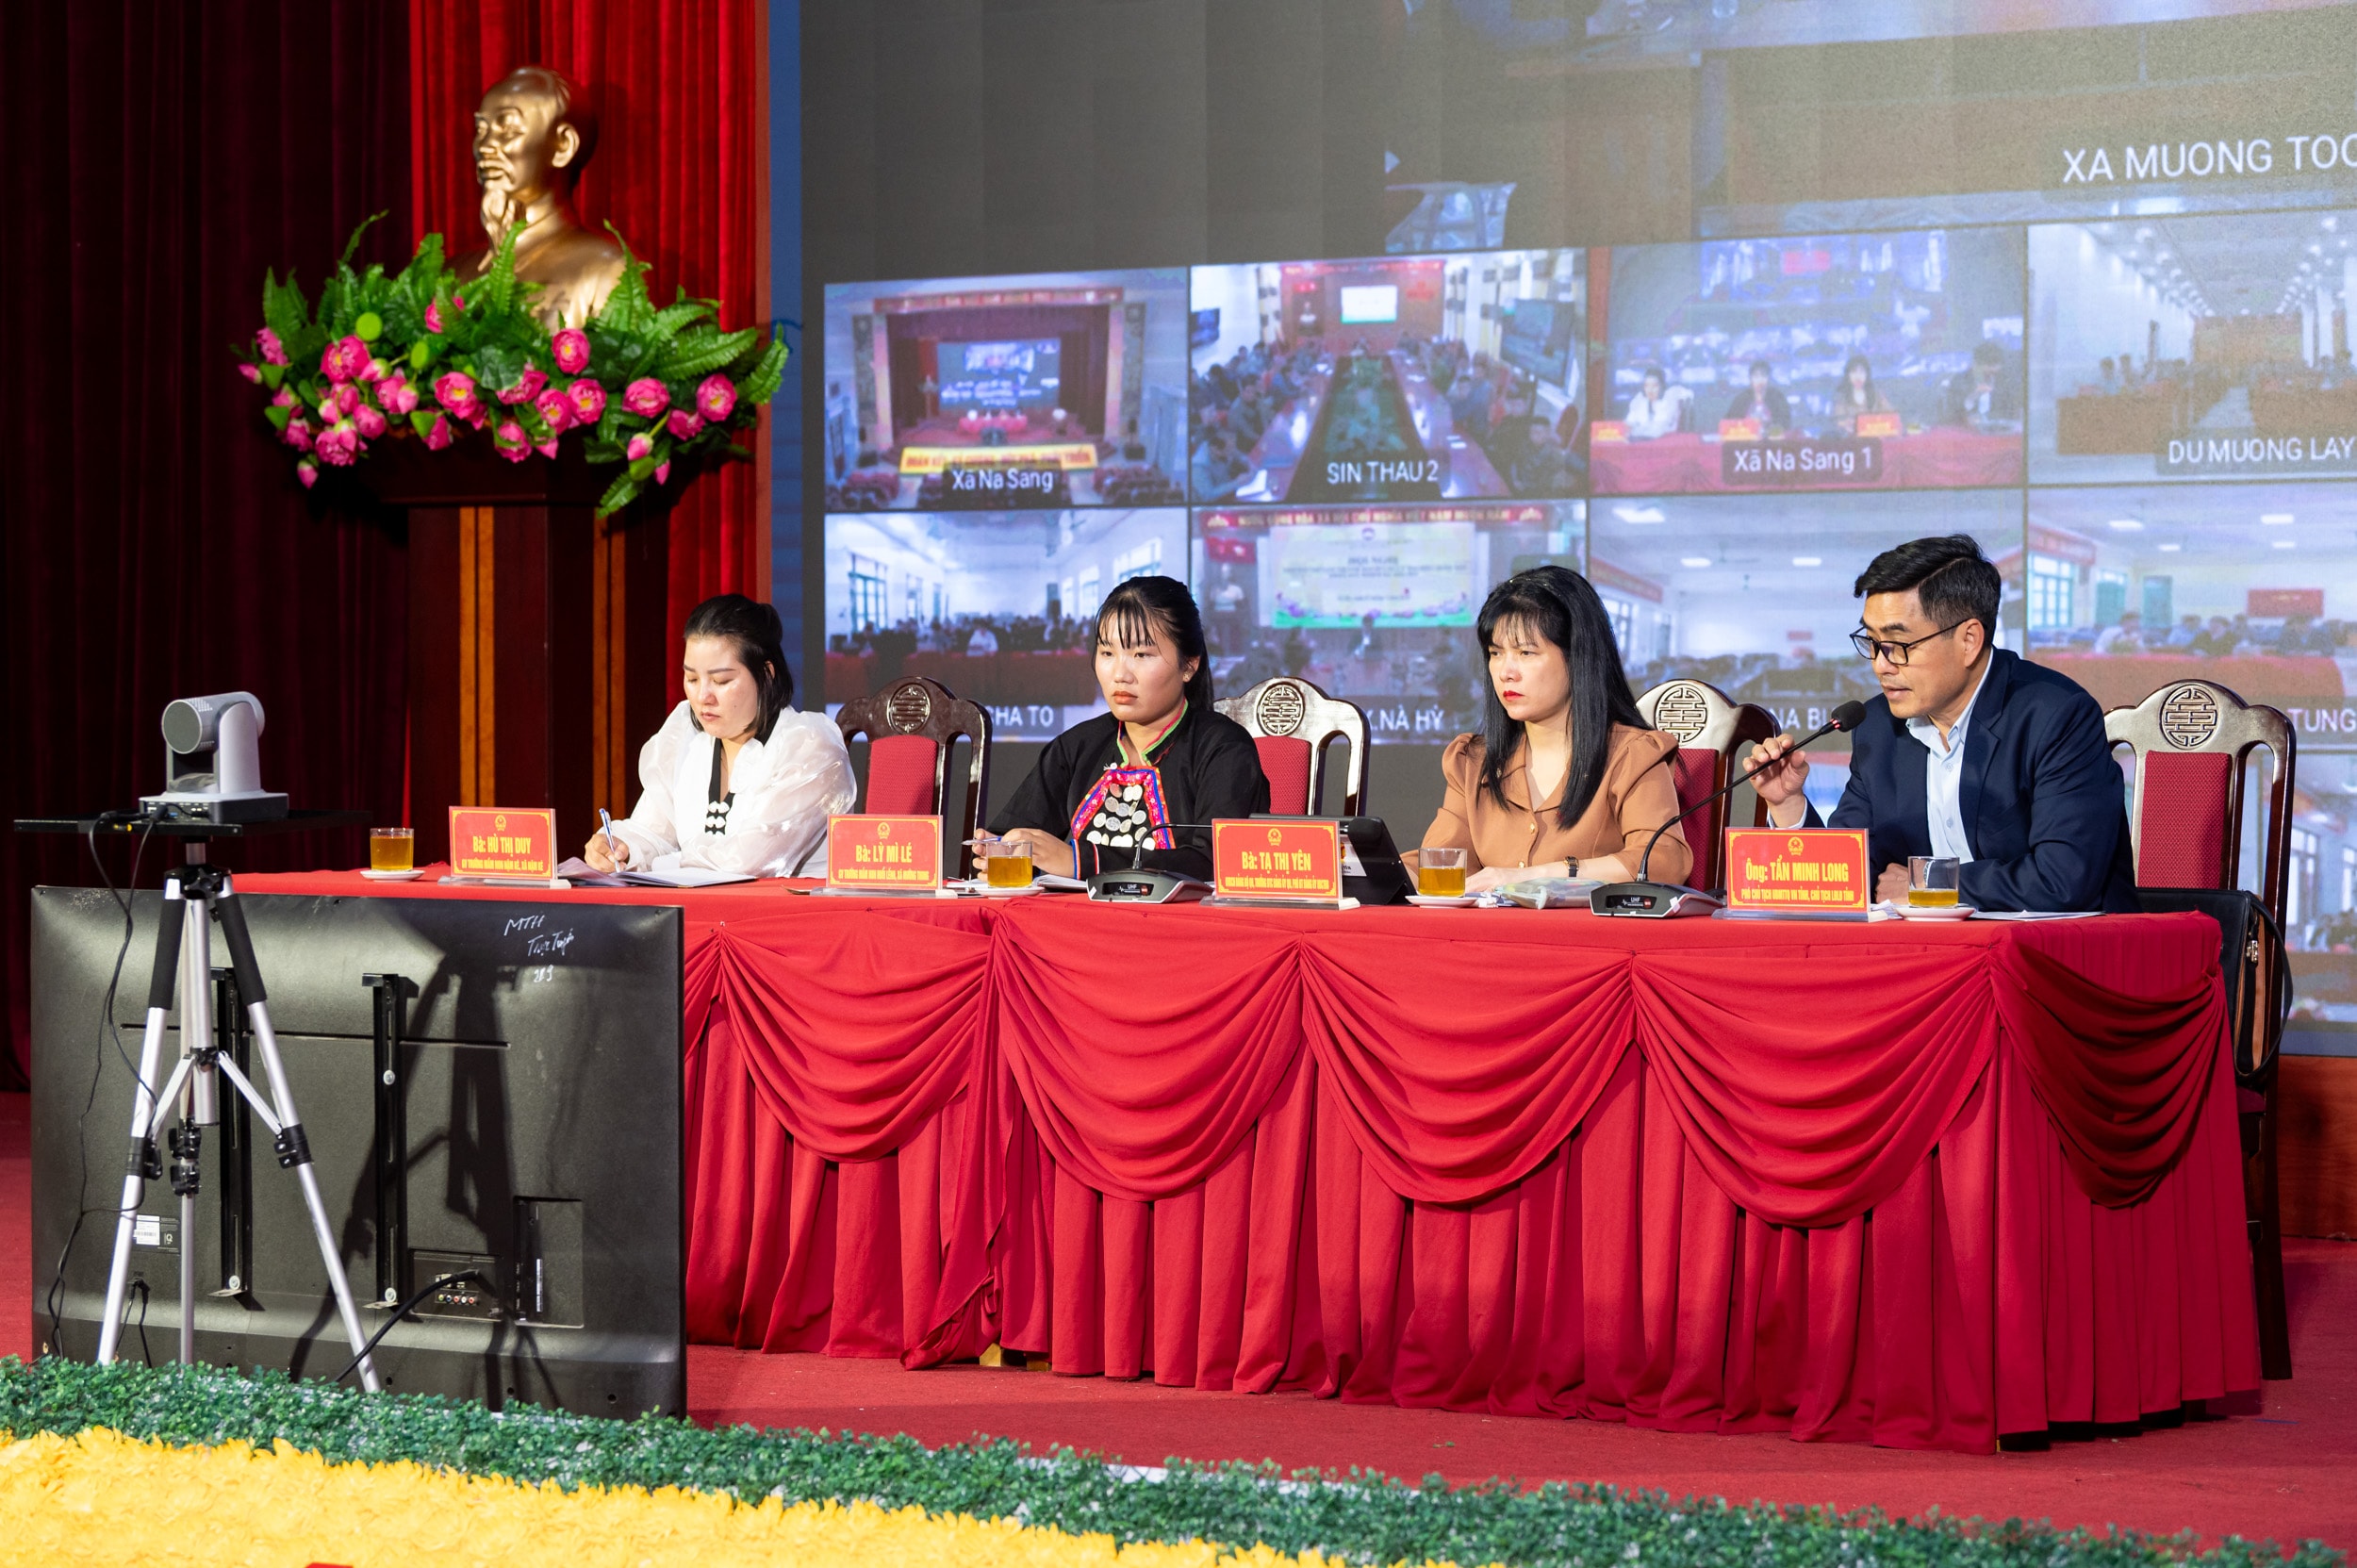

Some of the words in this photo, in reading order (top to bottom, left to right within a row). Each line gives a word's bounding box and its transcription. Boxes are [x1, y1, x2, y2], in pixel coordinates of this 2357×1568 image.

[2063, 147, 2114, 183] XA
[2126, 138, 2273, 179] MUONG
[1734, 448, 1761, 471] Xã
[1766, 449, 1795, 471] Na
[1800, 446, 1854, 474] Sang
[1862, 446, 1871, 469] 1
[2168, 439, 2203, 464] DU
[2208, 437, 2302, 463] MUONG
[2310, 437, 2355, 460] LAY
[979, 470, 1004, 488] Na
[1007, 468, 1053, 493] Sang
[1327, 462, 1362, 485] SIN
[1365, 460, 1424, 483] THAU
[1426, 459, 1439, 482] 2
[1027, 705, 1054, 727] TO
[2287, 708, 2356, 733] TUNG
[472, 835, 486, 853] Bà:
[500, 836, 514, 857] THỊ
[515, 837, 532, 854] DUY
[855, 844, 871, 863] Bà:
[900, 842, 912, 863] LÉ
[1242, 850, 1258, 869] Bà:
[1260, 851, 1272, 874] TẠ
[1274, 852, 1290, 875] THỊ
[1292, 849, 1311, 871] YÊN
[1746, 857, 1768, 883] Ông:
[1792, 862, 1820, 882] MINH
[1822, 863, 1849, 882] LONG
